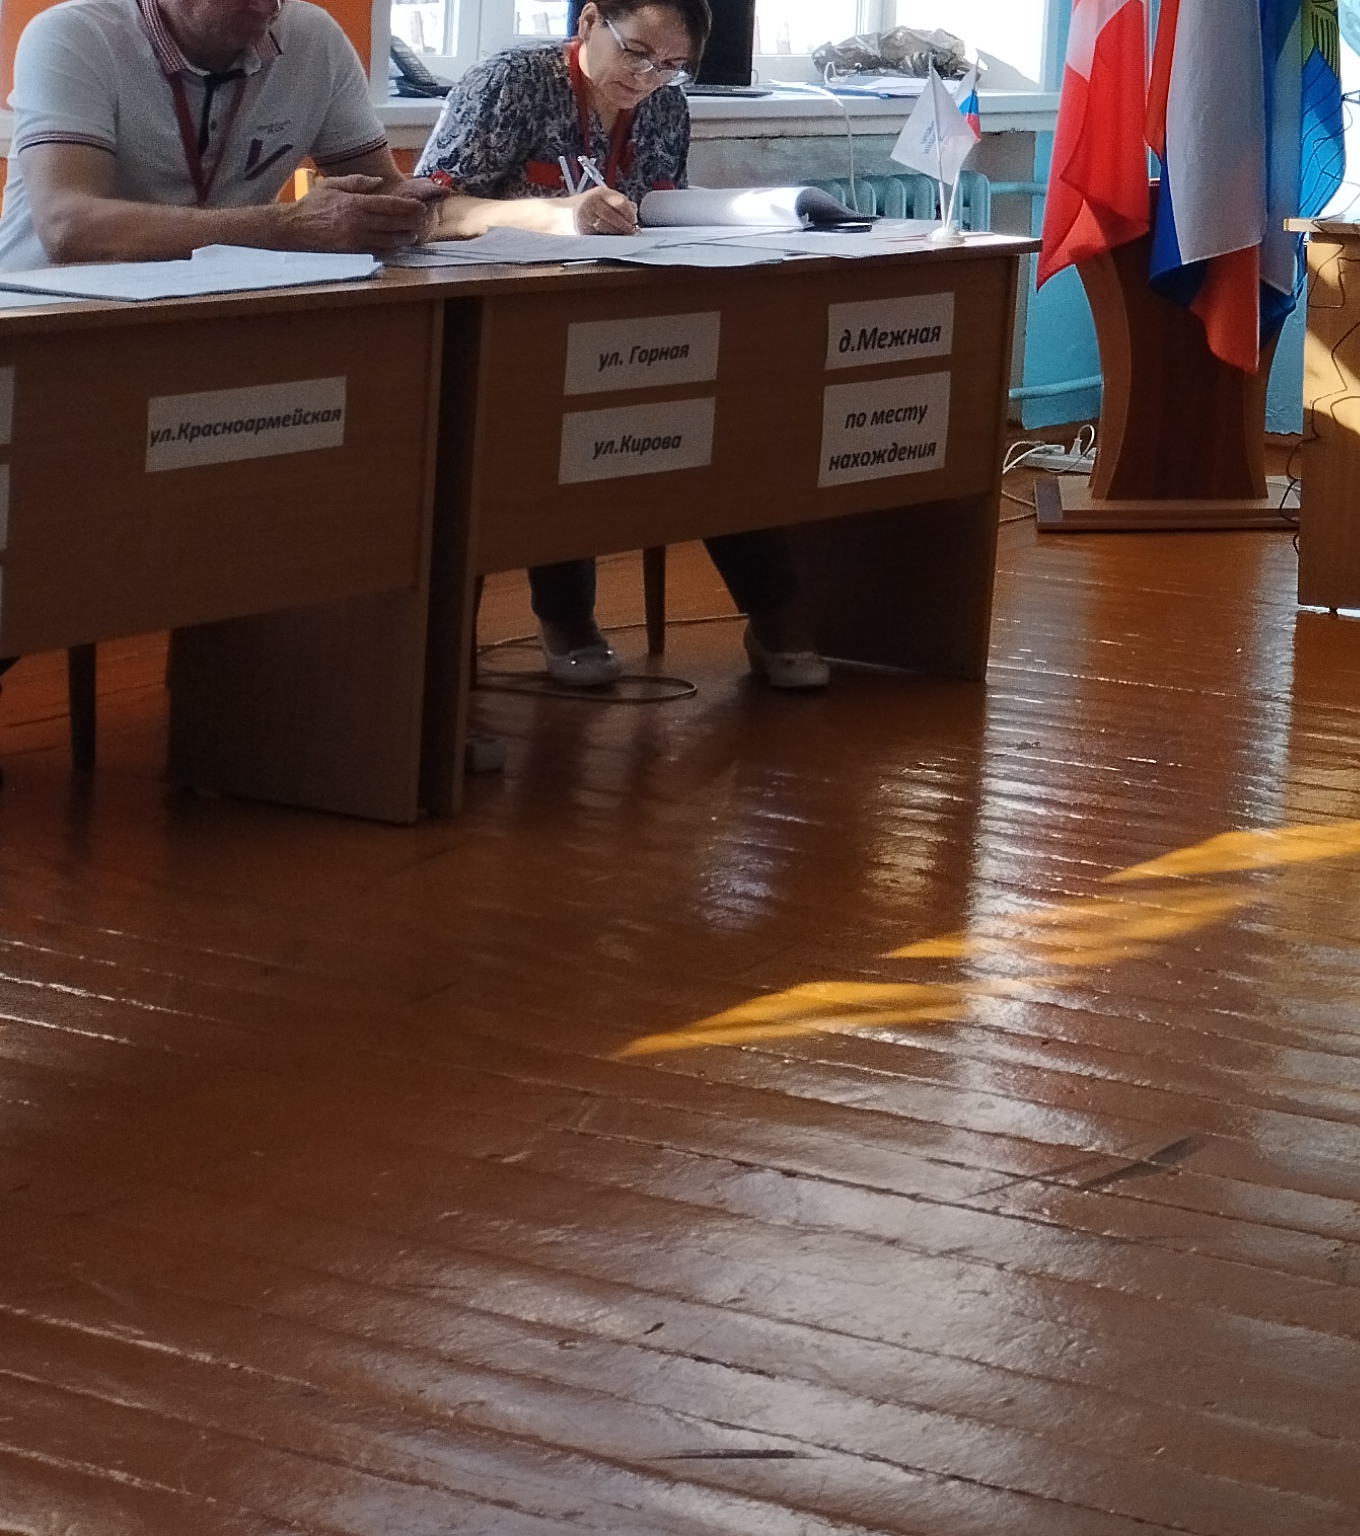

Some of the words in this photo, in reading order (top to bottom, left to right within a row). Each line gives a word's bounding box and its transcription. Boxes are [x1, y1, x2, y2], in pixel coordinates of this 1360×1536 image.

[838, 323, 943, 354] д.Межная
[598, 351, 624, 372] ул.
[630, 342, 690, 366] Горная
[150, 408, 343, 447] ул.Красноармейская
[844, 411, 867, 430] по
[870, 404, 928, 425] месту
[593, 433, 682, 460] ул.Кирова
[828, 441, 937, 472] нахождения
